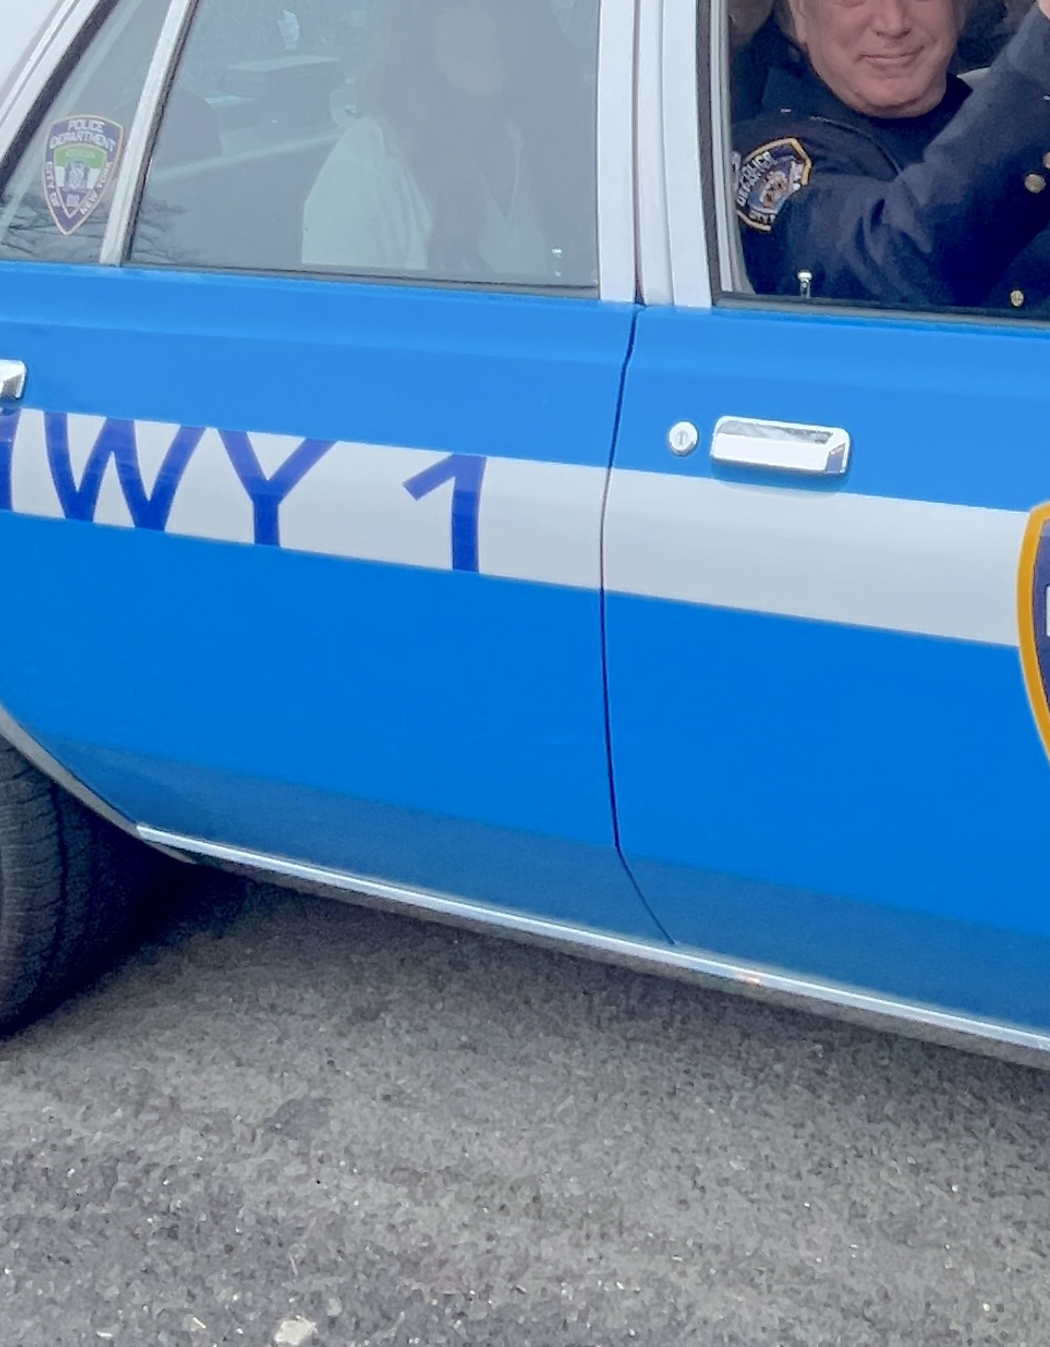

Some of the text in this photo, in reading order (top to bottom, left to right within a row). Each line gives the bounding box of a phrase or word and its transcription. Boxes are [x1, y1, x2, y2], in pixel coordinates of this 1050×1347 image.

[68, 119, 105, 133] POLICE
[49, 131, 116, 152] DEPARTMENT
[80, 190, 98, 215] NEW
[403, 454, 488, 574] 1
